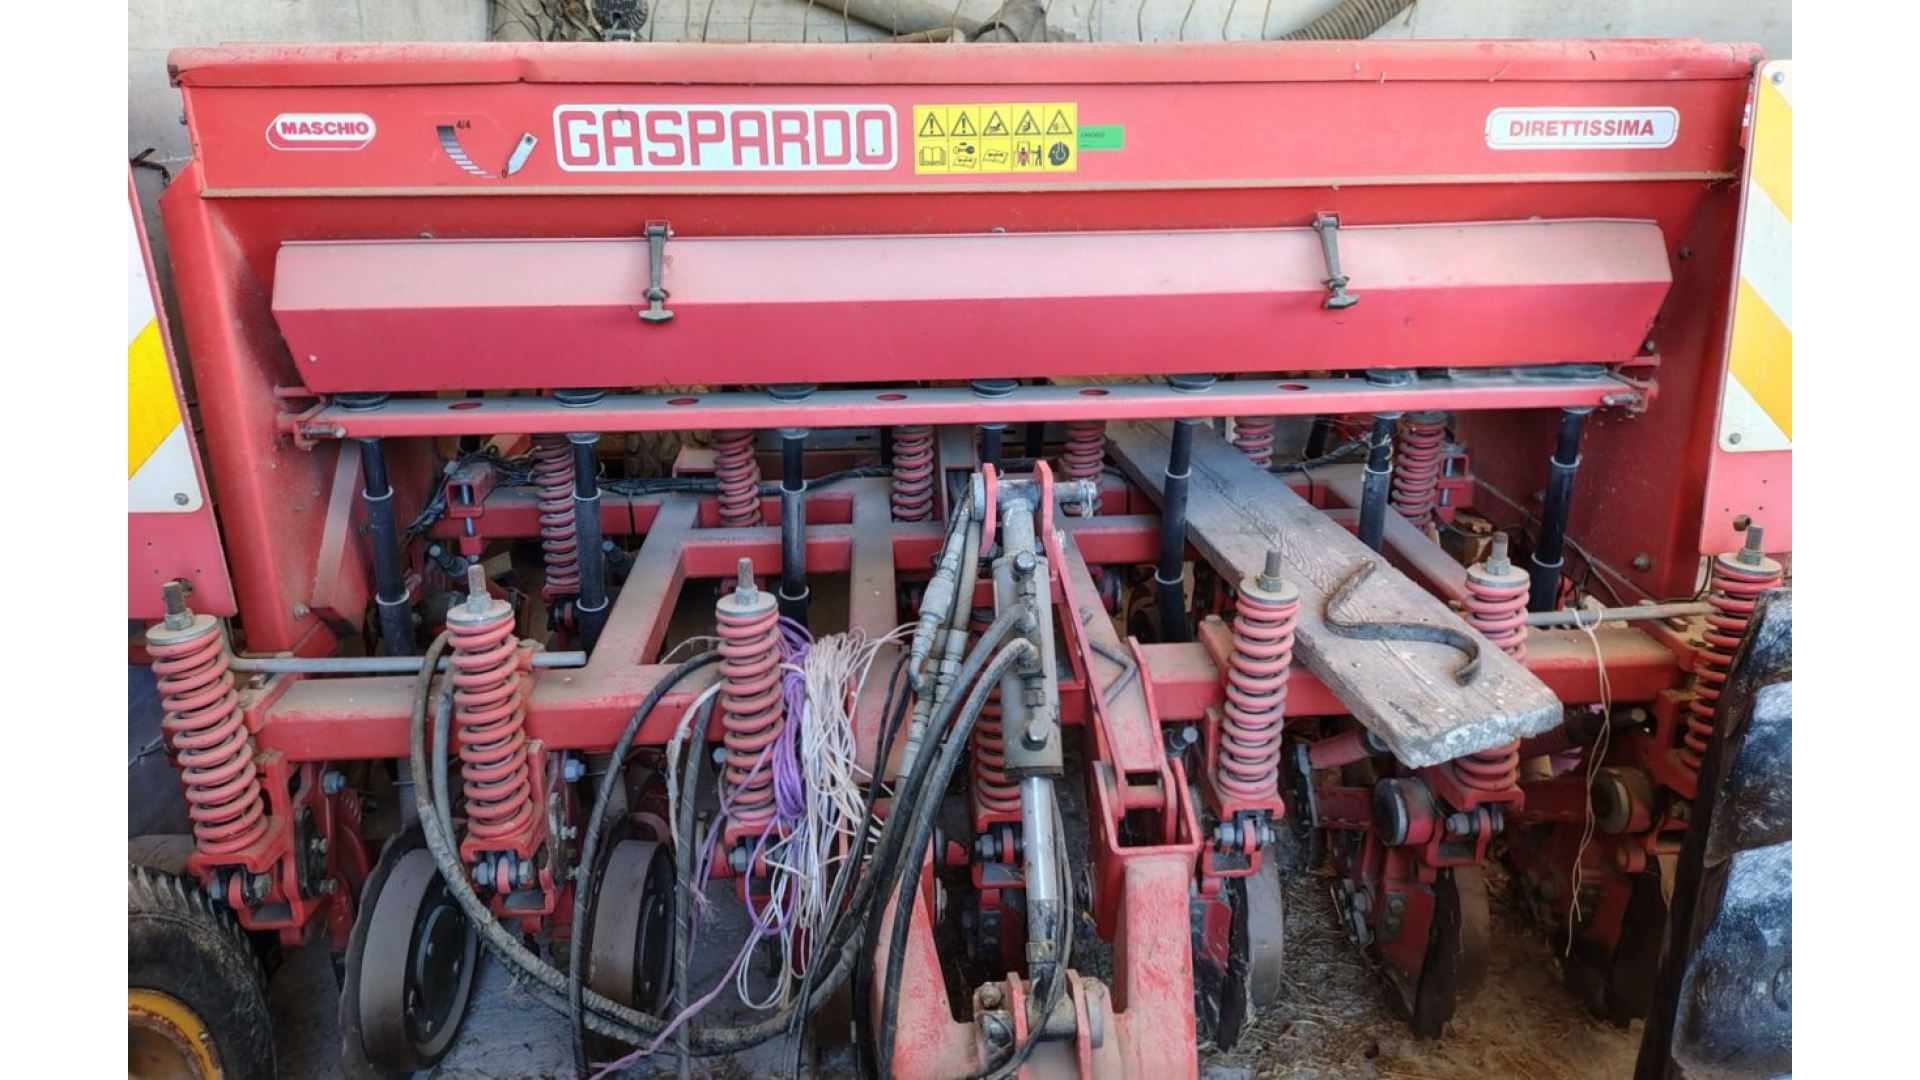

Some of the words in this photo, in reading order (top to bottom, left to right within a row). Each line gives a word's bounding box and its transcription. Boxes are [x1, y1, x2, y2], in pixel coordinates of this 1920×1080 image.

[281, 122, 369, 135] MASCHIO
[456, 120, 471, 129] 4/4
[1509, 119, 1654, 137] DIRETTISSIMA
[559, 110, 892, 166] GASPARDO
